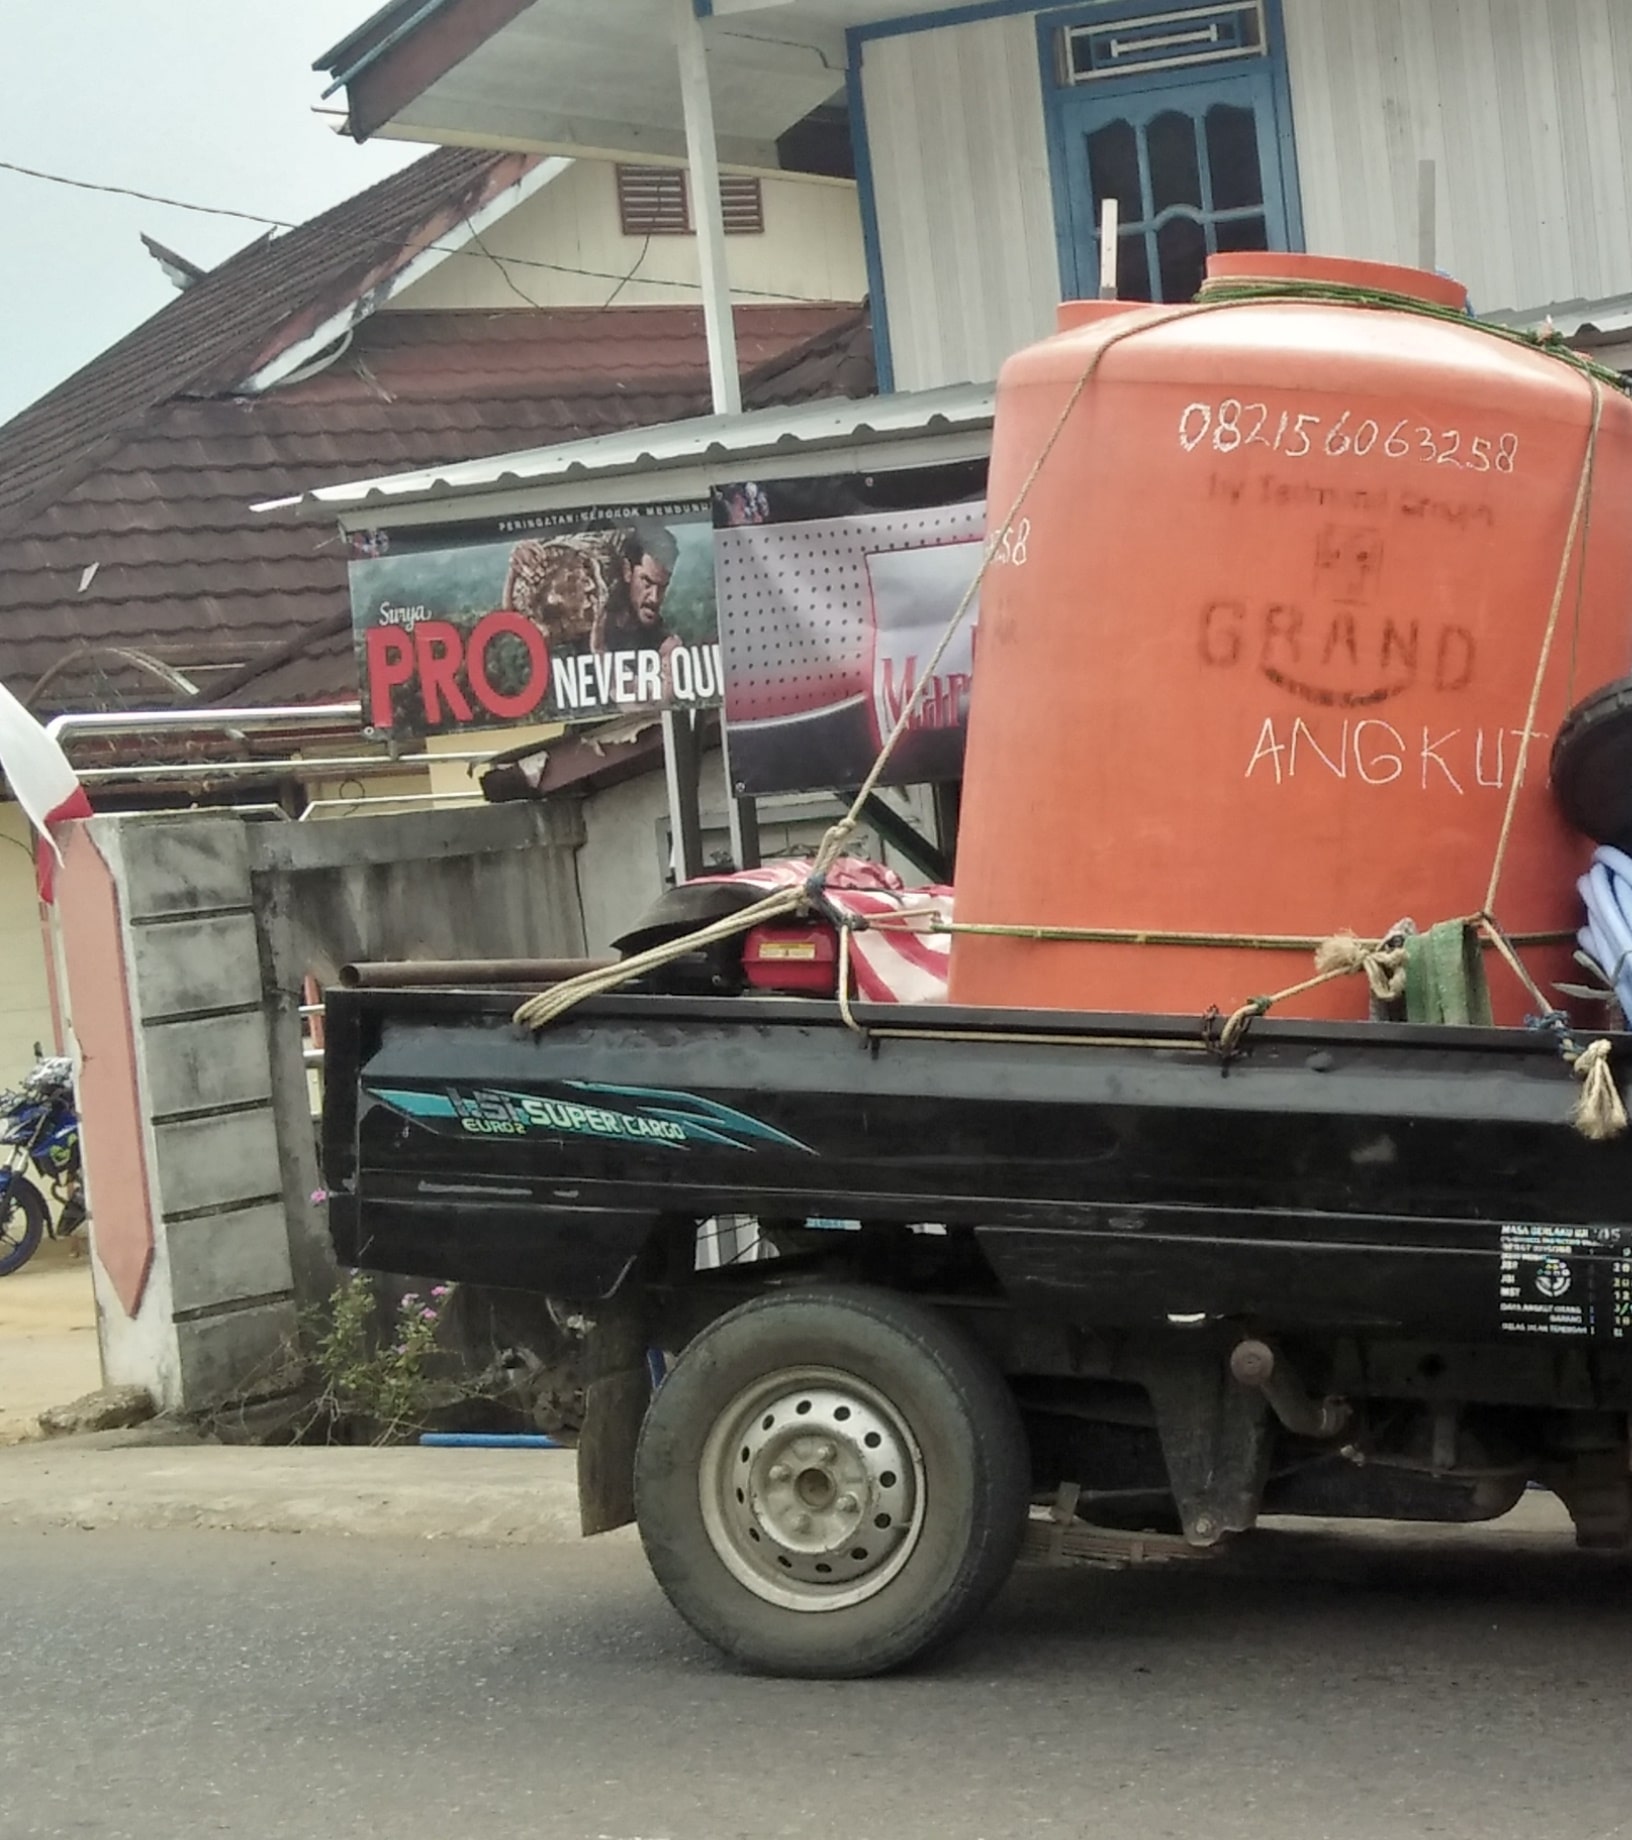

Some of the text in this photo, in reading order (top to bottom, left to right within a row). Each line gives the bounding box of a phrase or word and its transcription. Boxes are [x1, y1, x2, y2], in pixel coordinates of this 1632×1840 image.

[1179, 399, 1518, 473] 082156063258
[379, 601, 432, 632] Surya
[1197, 597, 1477, 692] GRAND
[366, 611, 724, 728] PRO NEVER QUI
[522, 1099, 686, 1141] SUPER CARGO
